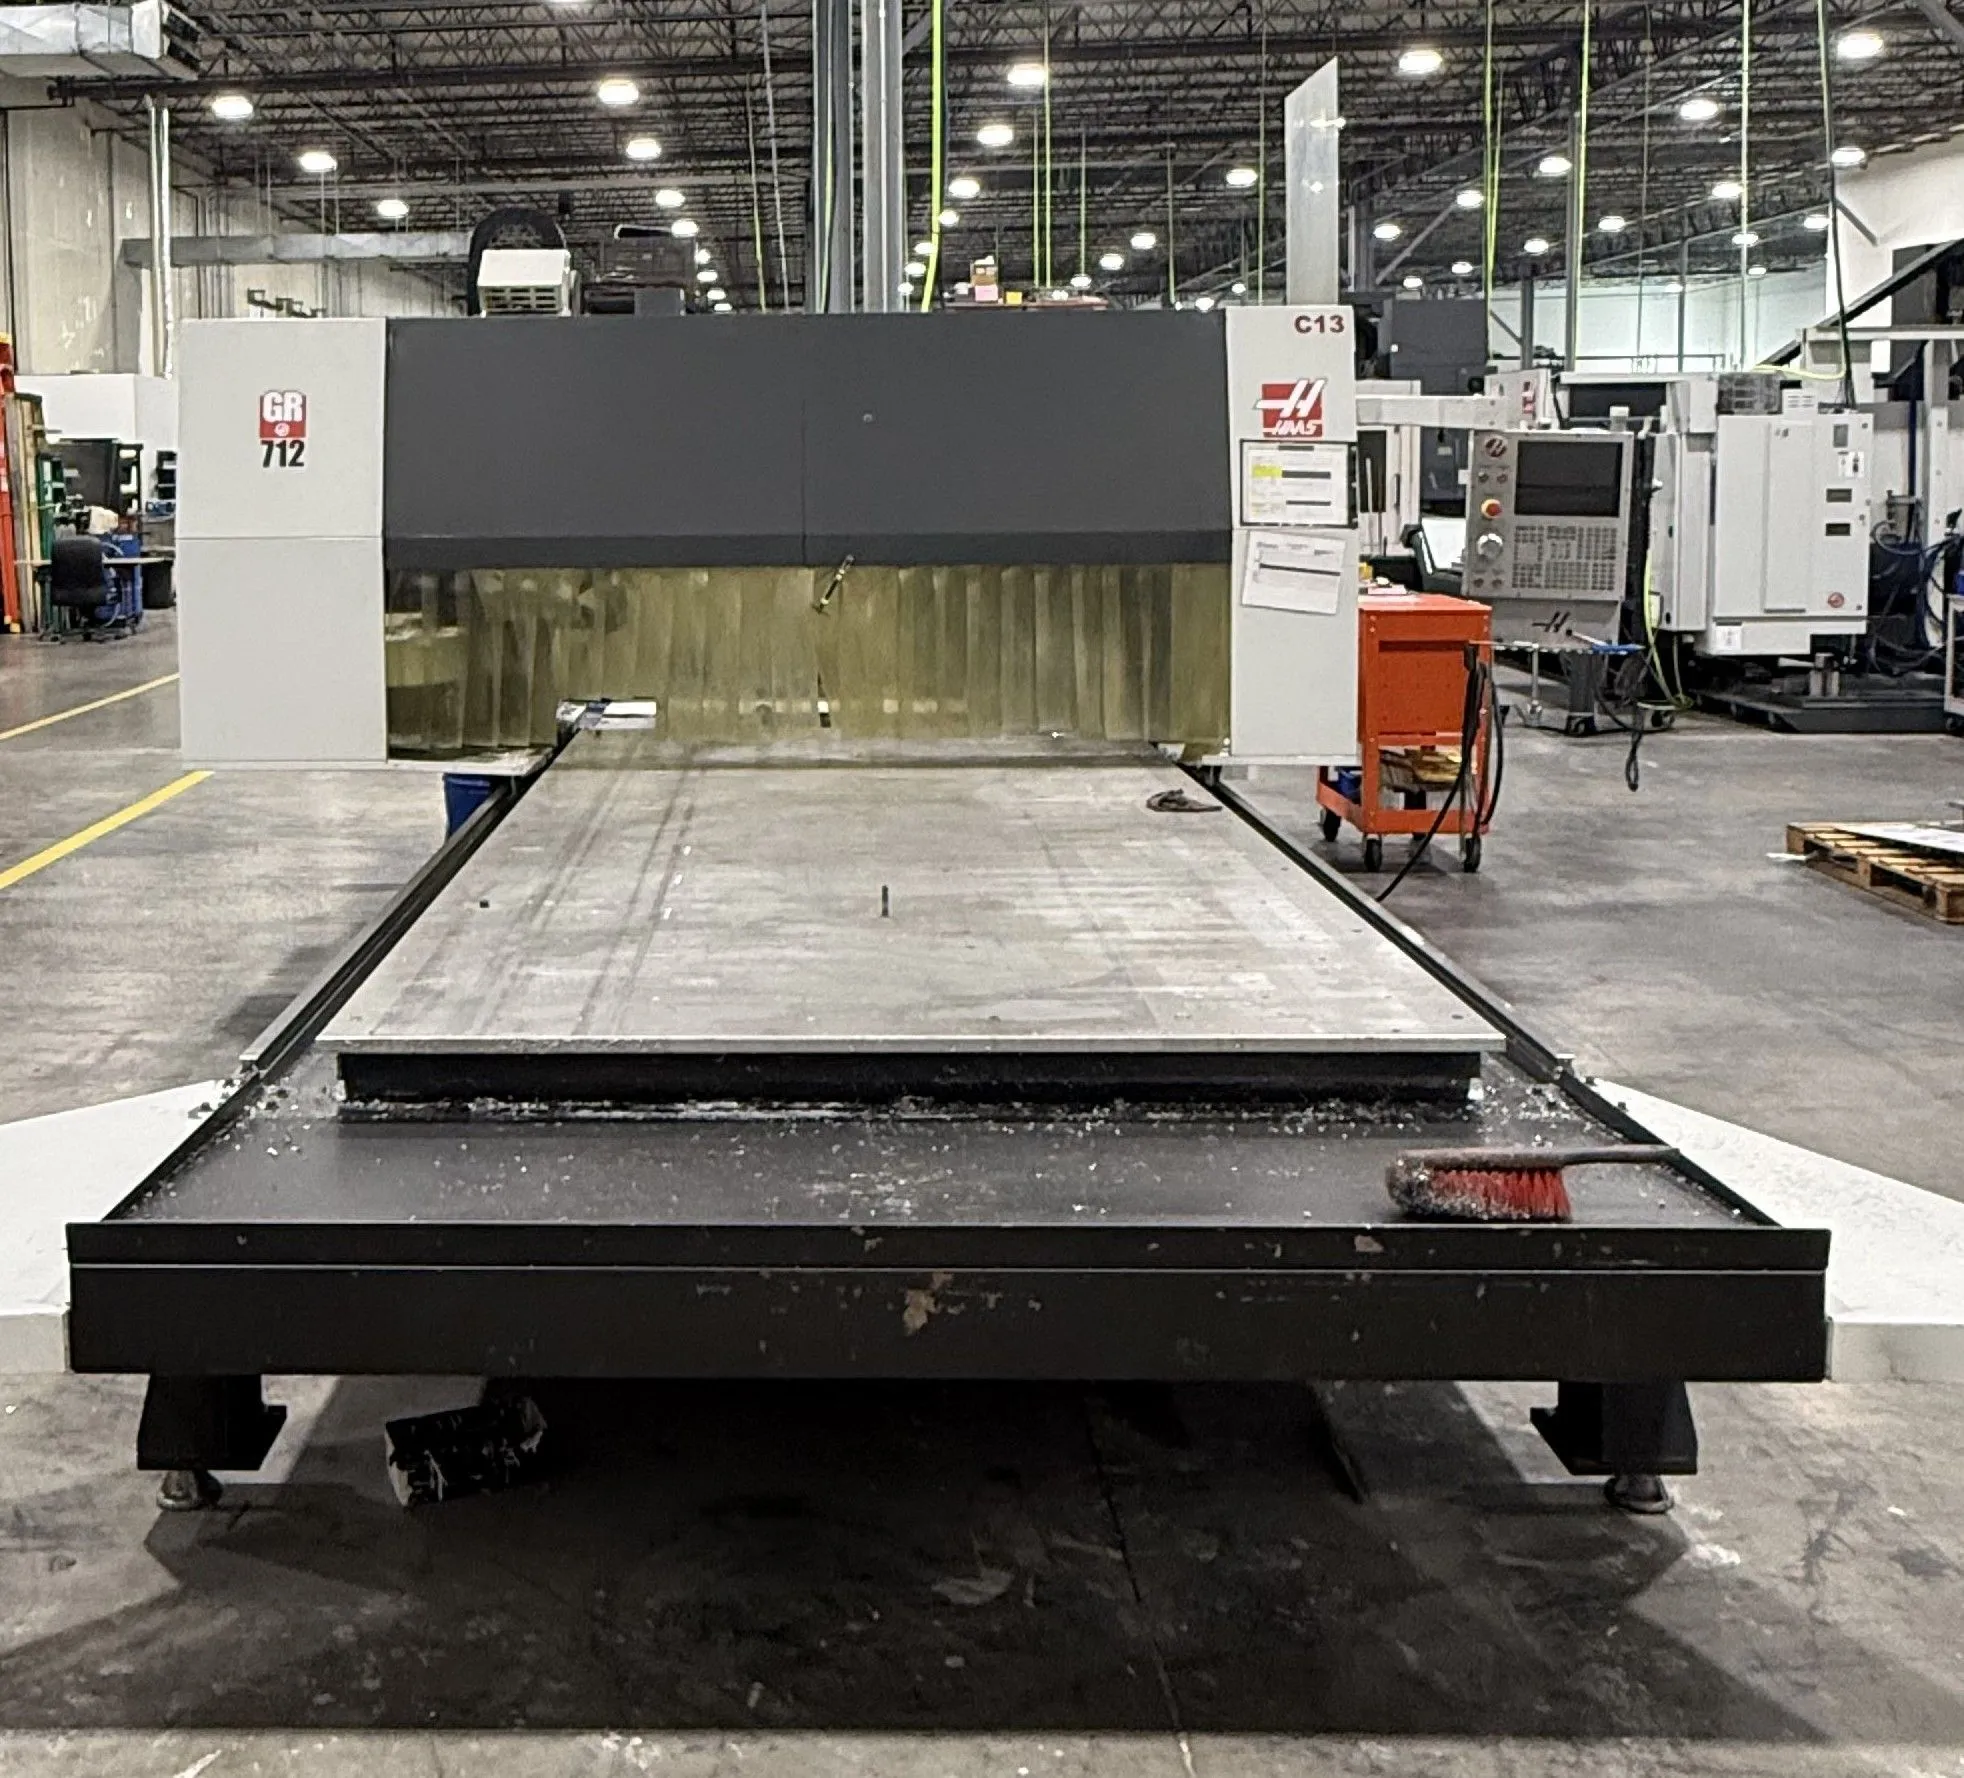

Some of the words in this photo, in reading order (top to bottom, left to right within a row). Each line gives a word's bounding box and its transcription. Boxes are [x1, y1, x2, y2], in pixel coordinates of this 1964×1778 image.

[1294, 315, 1345, 334] C13
[262, 391, 303, 423] GR
[1262, 419, 1322, 436] HAAS
[260, 439, 305, 468] 712
